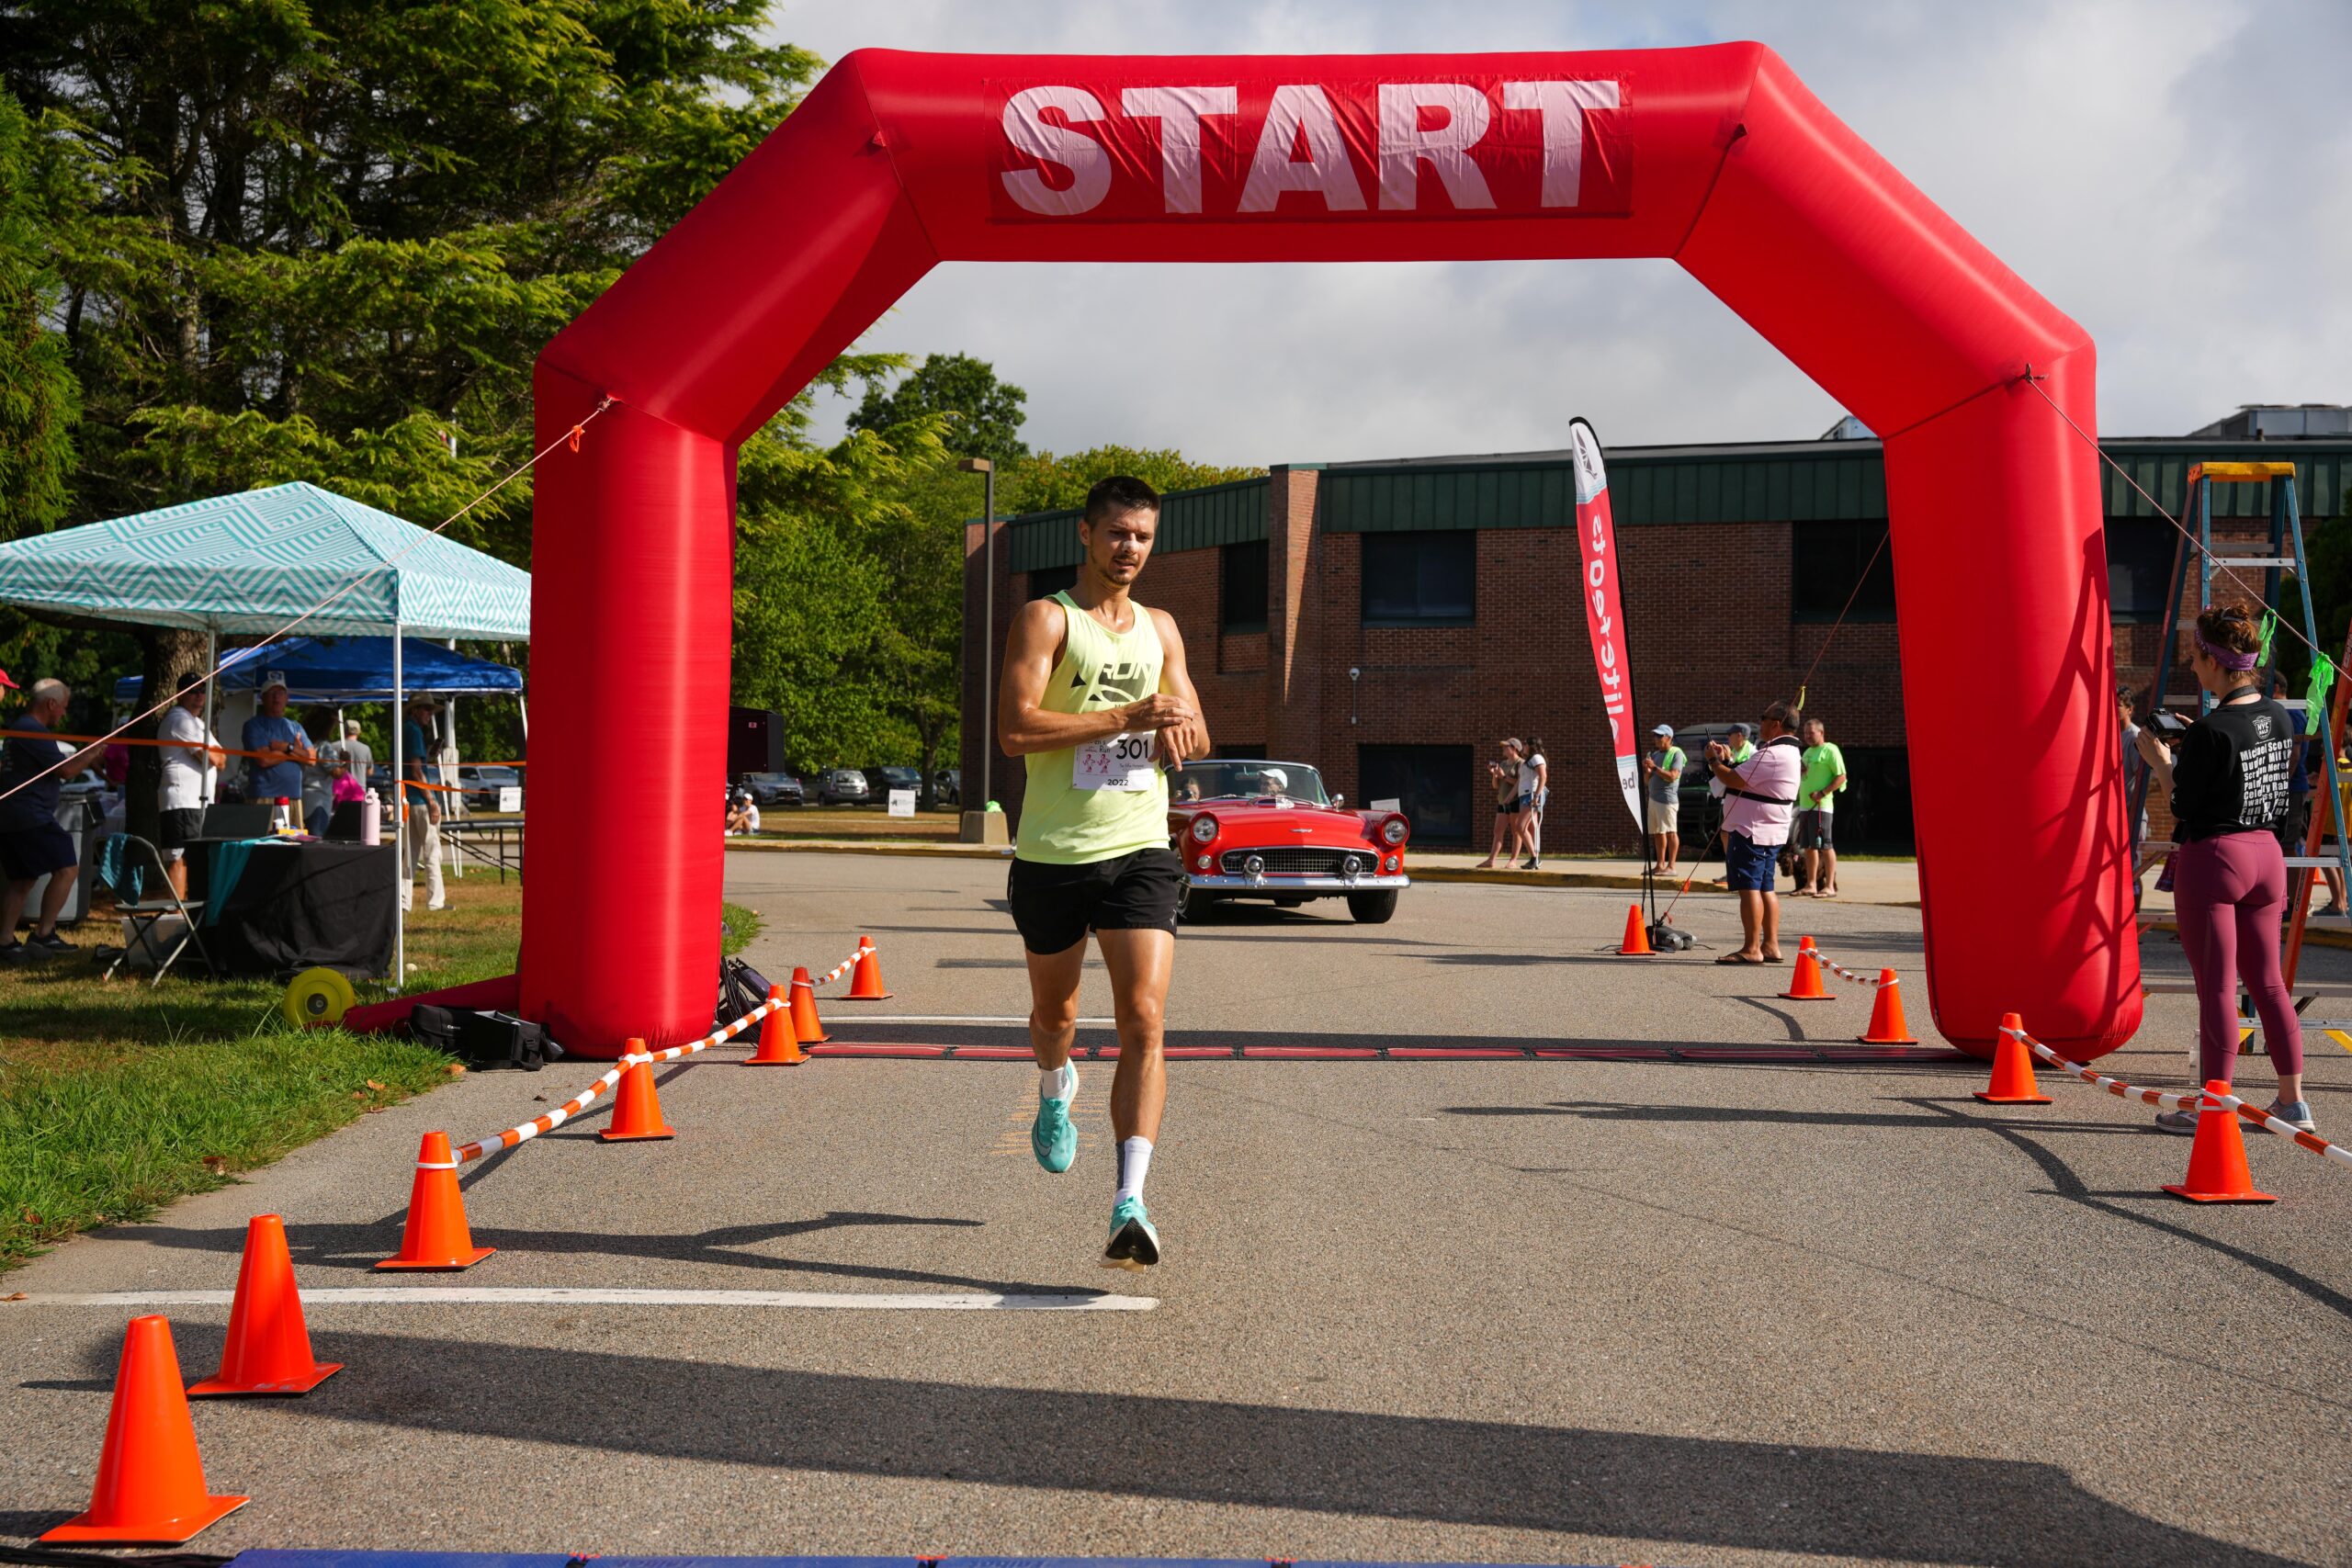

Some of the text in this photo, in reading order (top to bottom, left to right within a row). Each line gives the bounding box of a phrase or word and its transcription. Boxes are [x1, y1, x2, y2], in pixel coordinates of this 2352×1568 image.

[1001, 80, 1620, 216] START
[2257, 722, 2269, 731] NYC
[1115, 739, 1148, 760] 301
